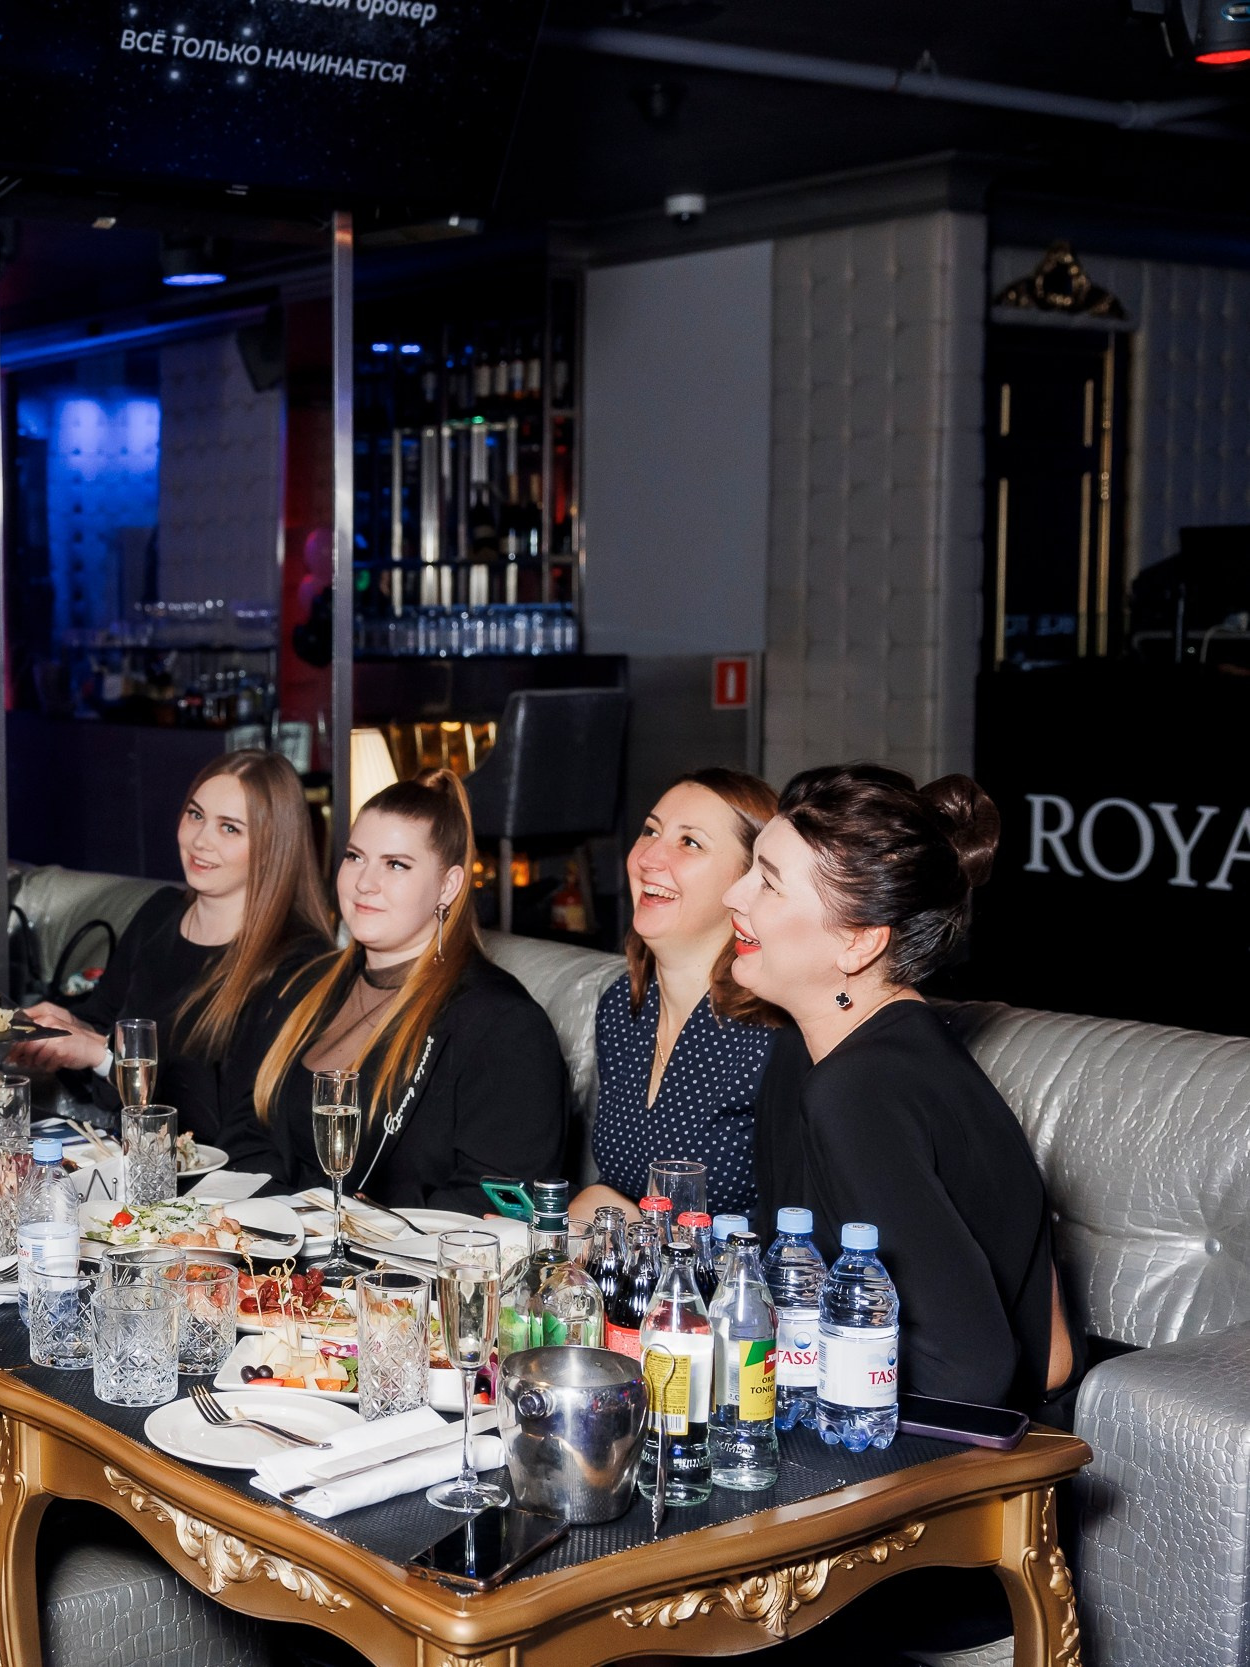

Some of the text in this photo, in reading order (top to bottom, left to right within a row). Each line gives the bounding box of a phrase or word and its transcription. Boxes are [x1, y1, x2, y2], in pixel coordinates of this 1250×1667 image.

[120, 29, 407, 84] ВСЁ ТОЛЬКО НАЧИНАЕТСЯ
[777, 1350, 818, 1365] TASSA
[750, 1384, 774, 1394] TONIC
